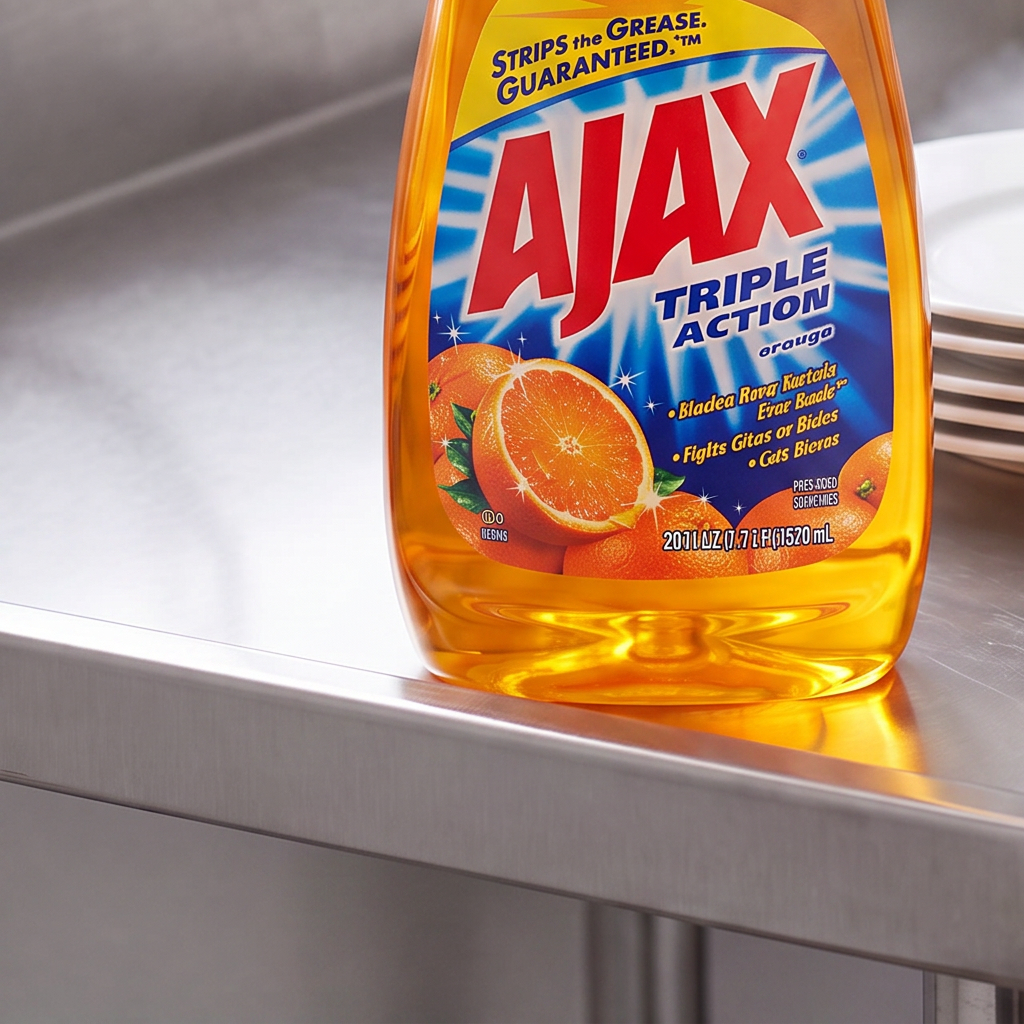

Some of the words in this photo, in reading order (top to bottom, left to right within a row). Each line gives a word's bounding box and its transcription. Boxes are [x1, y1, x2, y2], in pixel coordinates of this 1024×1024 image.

[491, 34, 568, 79] STRIPS
[572, 32, 603, 51] the
[606, 11, 707, 42] GREASE.
[467, 61, 824, 339] AJAX
[655, 246, 829, 321] TRIPLE
[672, 283, 830, 349] ACTION
